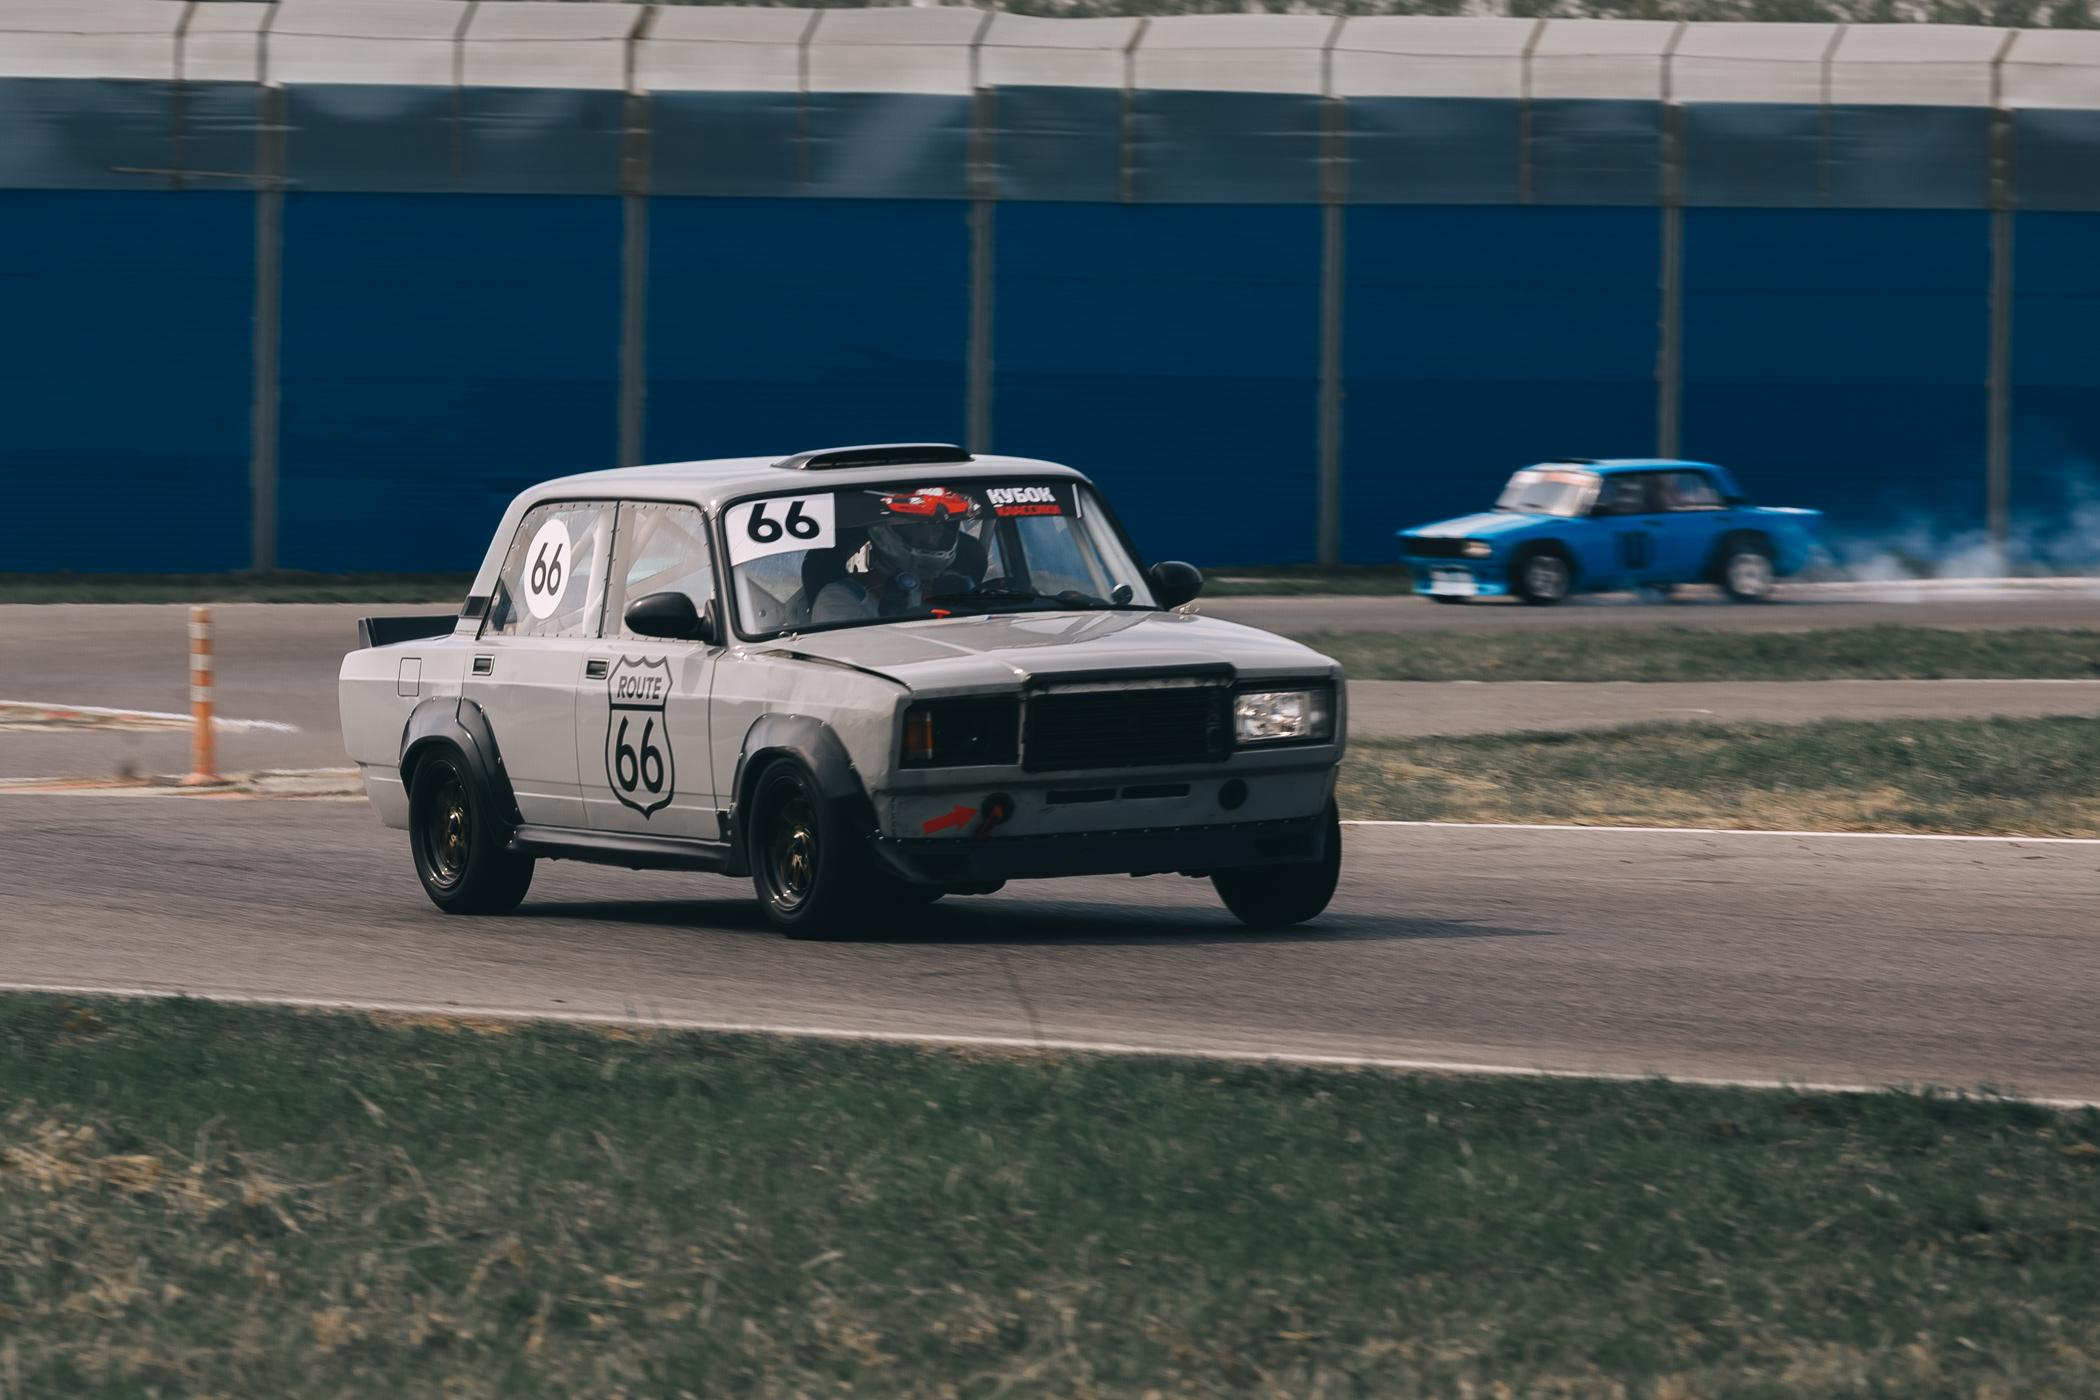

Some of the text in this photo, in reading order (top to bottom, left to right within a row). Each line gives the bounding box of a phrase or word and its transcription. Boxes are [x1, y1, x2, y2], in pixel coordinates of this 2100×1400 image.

[986, 487, 1056, 505] КУБОК
[748, 501, 820, 543] 66
[531, 543, 562, 596] 66
[616, 675, 663, 701] ROUTE
[615, 715, 665, 794] 66
